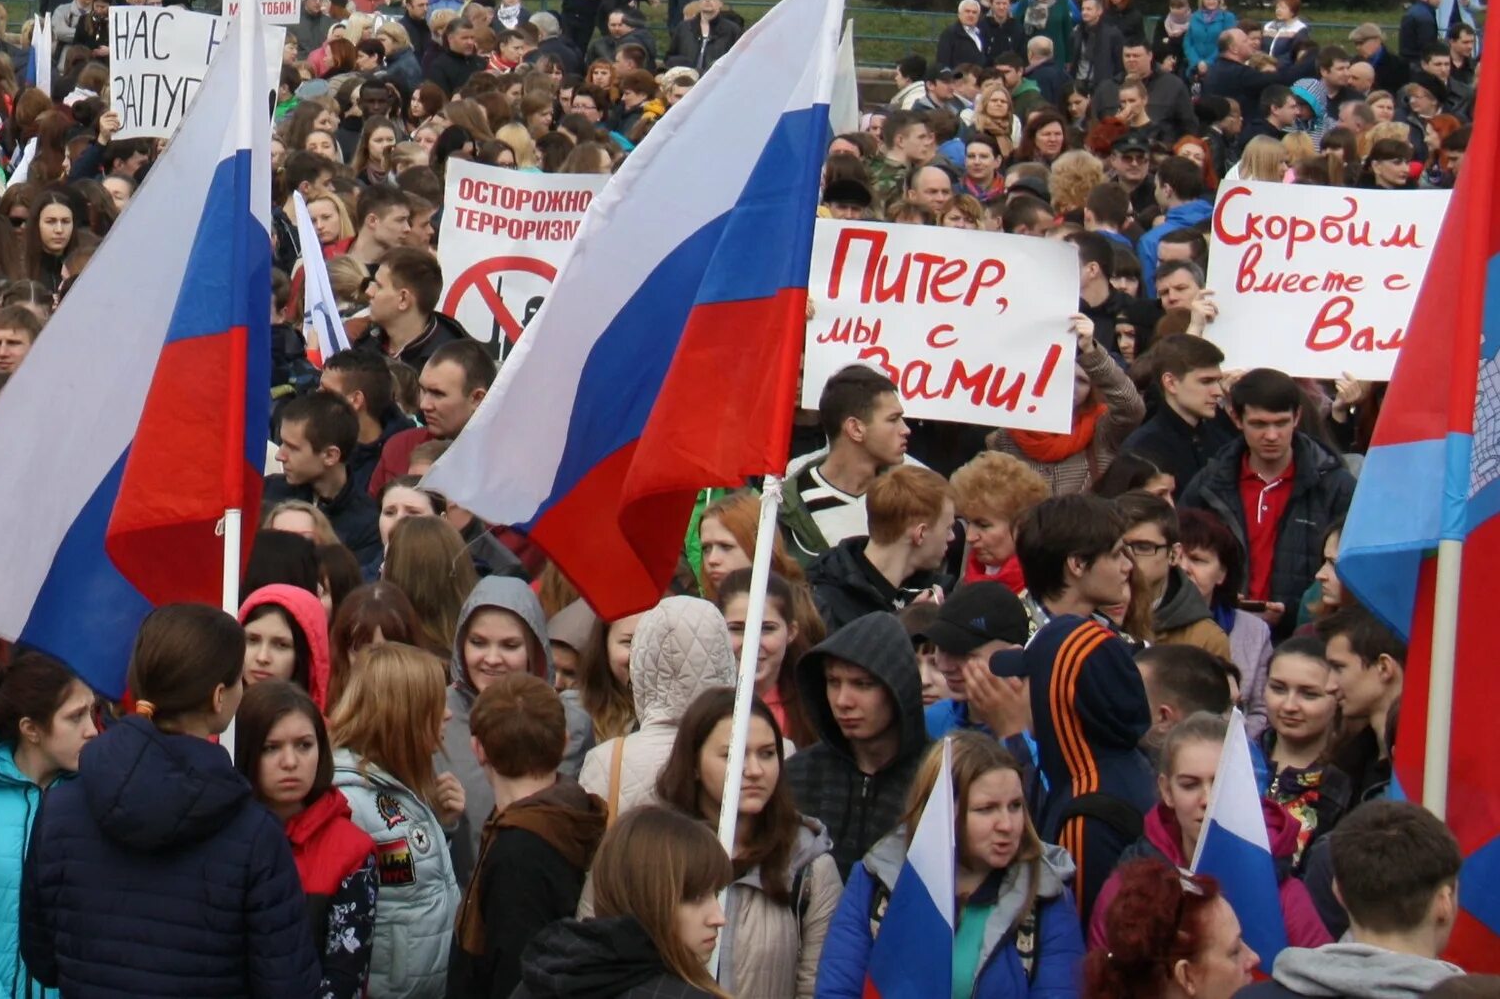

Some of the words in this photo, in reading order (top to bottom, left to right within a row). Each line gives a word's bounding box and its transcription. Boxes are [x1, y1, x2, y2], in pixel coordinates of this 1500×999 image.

[114, 11, 175, 61] НАС
[458, 177, 594, 213] ОСТОРОЖНО
[1213, 186, 1426, 260] Скорбим
[827, 228, 1009, 314] Питер,
[1235, 243, 1365, 293] вместе
[1383, 274, 1411, 291] с
[816, 316, 882, 345] мы
[926, 323, 959, 349] с
